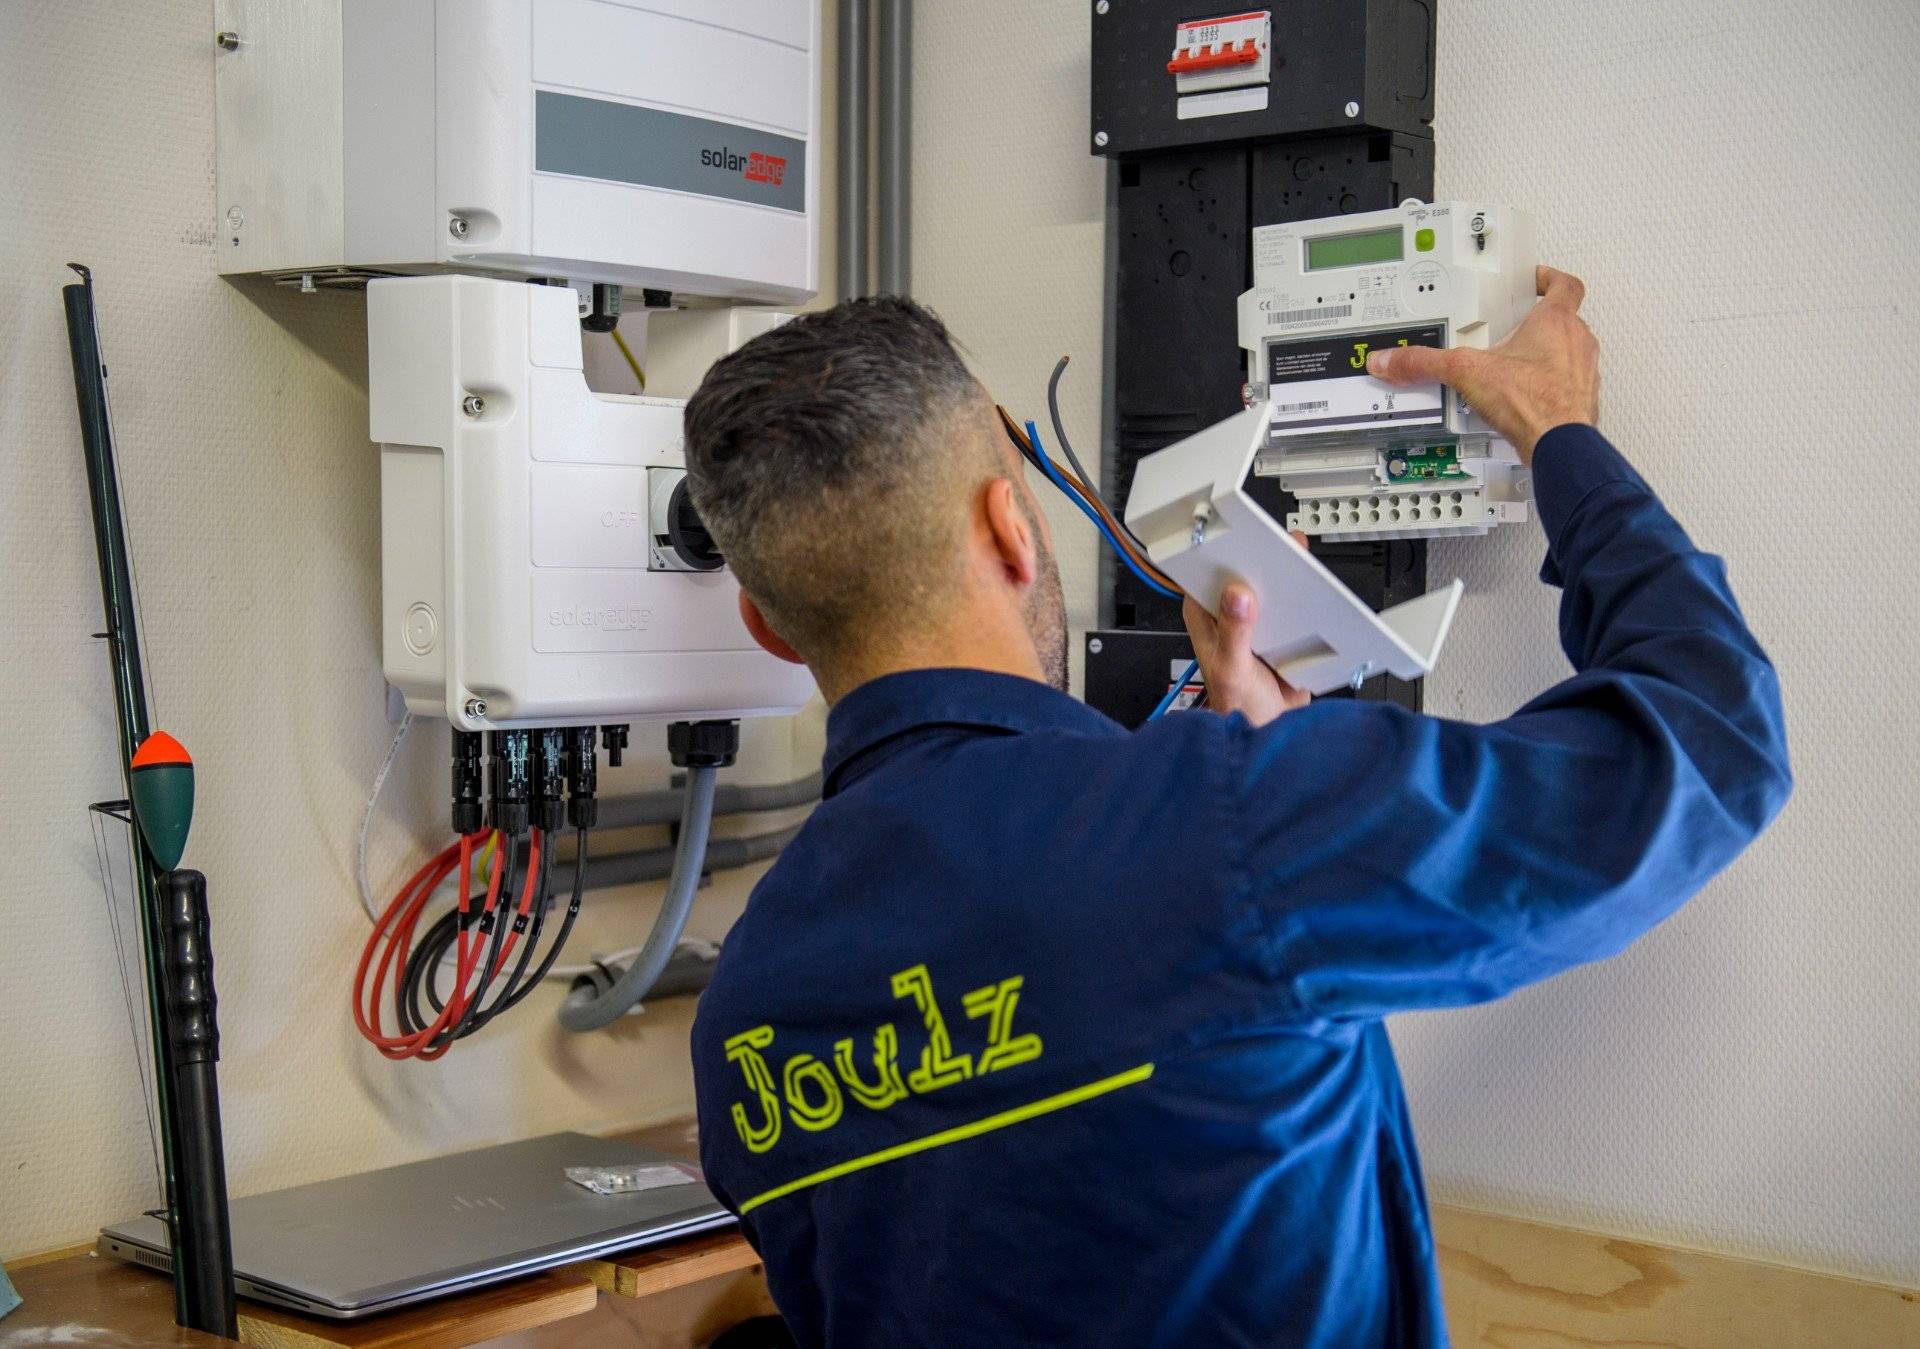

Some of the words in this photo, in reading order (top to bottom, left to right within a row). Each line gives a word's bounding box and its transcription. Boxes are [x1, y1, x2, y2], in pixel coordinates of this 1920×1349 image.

[701, 147, 785, 185] solaredge
[600, 510, 640, 528] OFF
[548, 600, 651, 630] solaredge
[724, 963, 1044, 1154] Joulz
